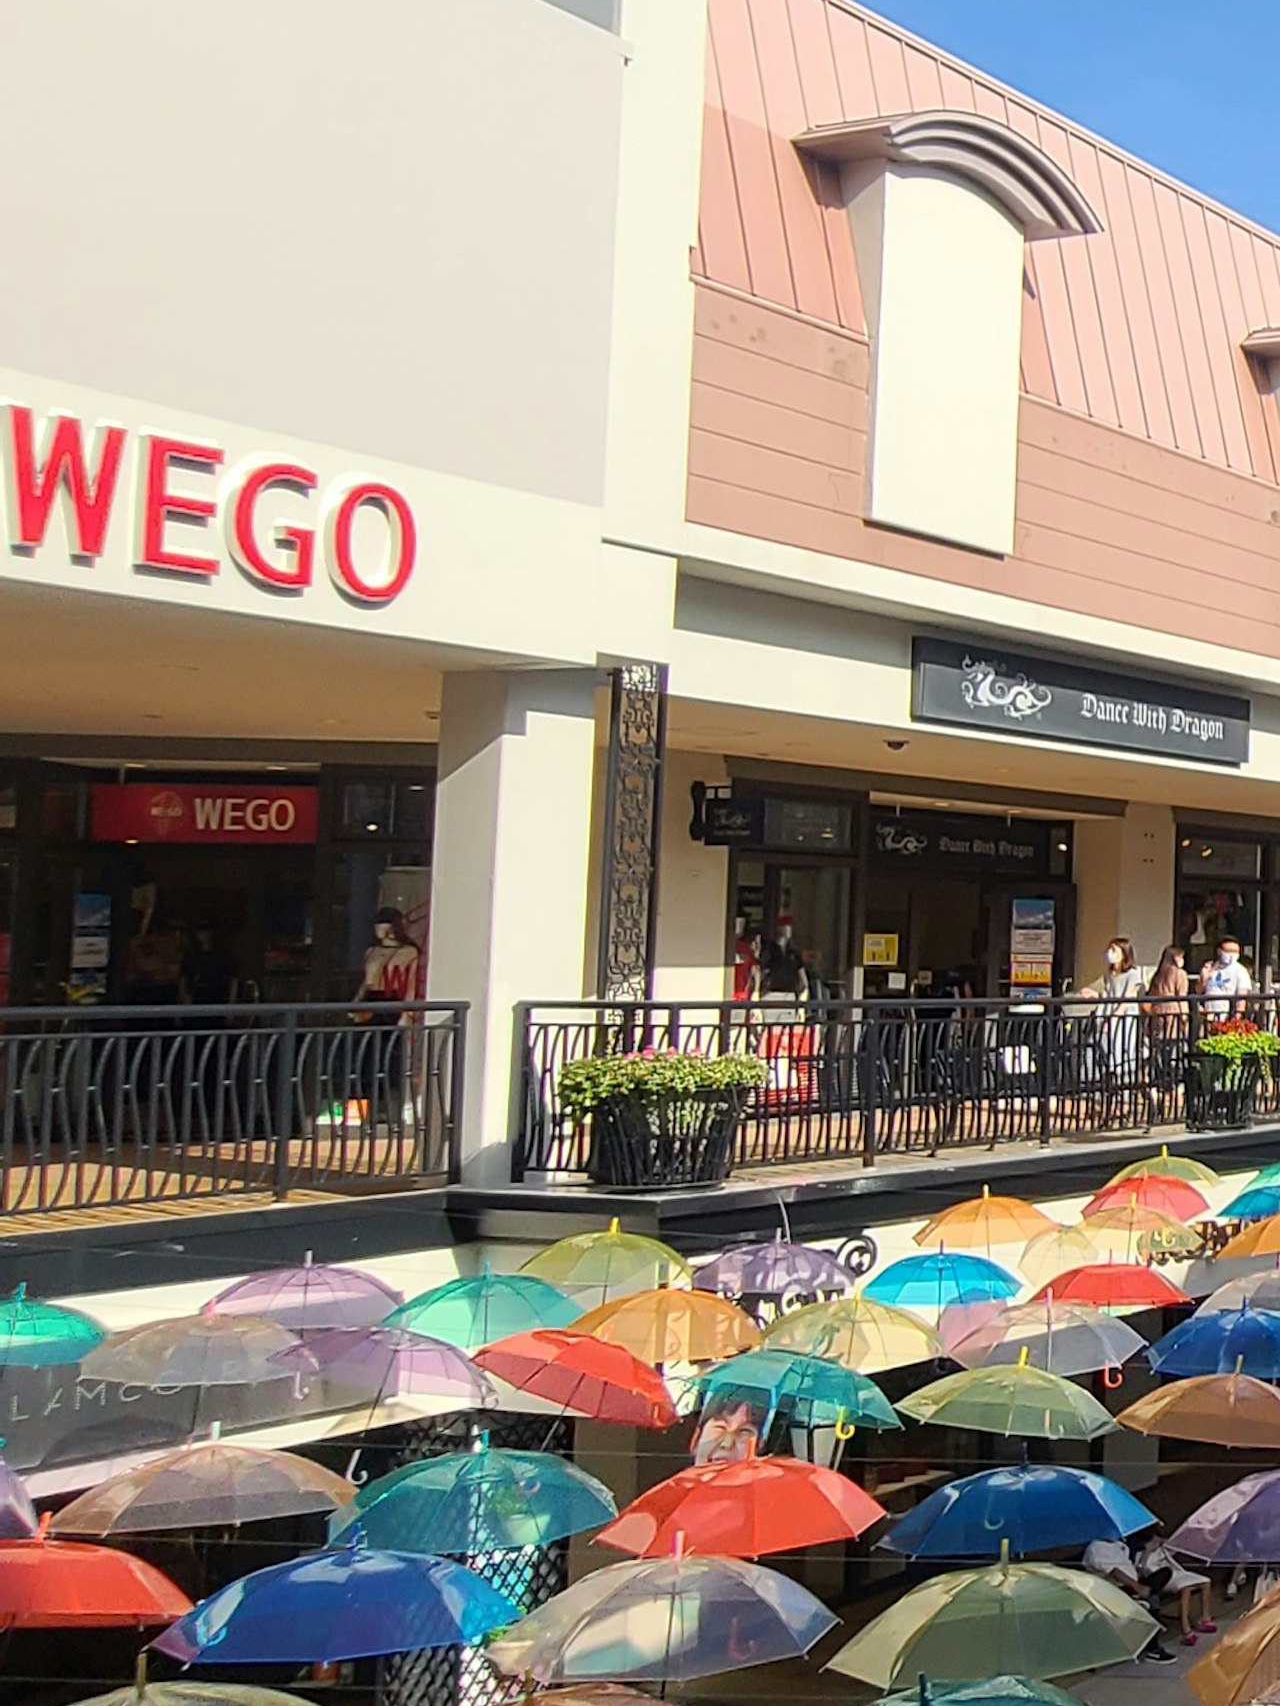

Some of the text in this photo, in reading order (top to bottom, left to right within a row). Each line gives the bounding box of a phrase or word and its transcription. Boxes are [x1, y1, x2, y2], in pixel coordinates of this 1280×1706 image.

[8, 403, 417, 605] WEGO
[1080, 693, 1224, 742] Dance With Dragon
[194, 797, 296, 832] WEGO
